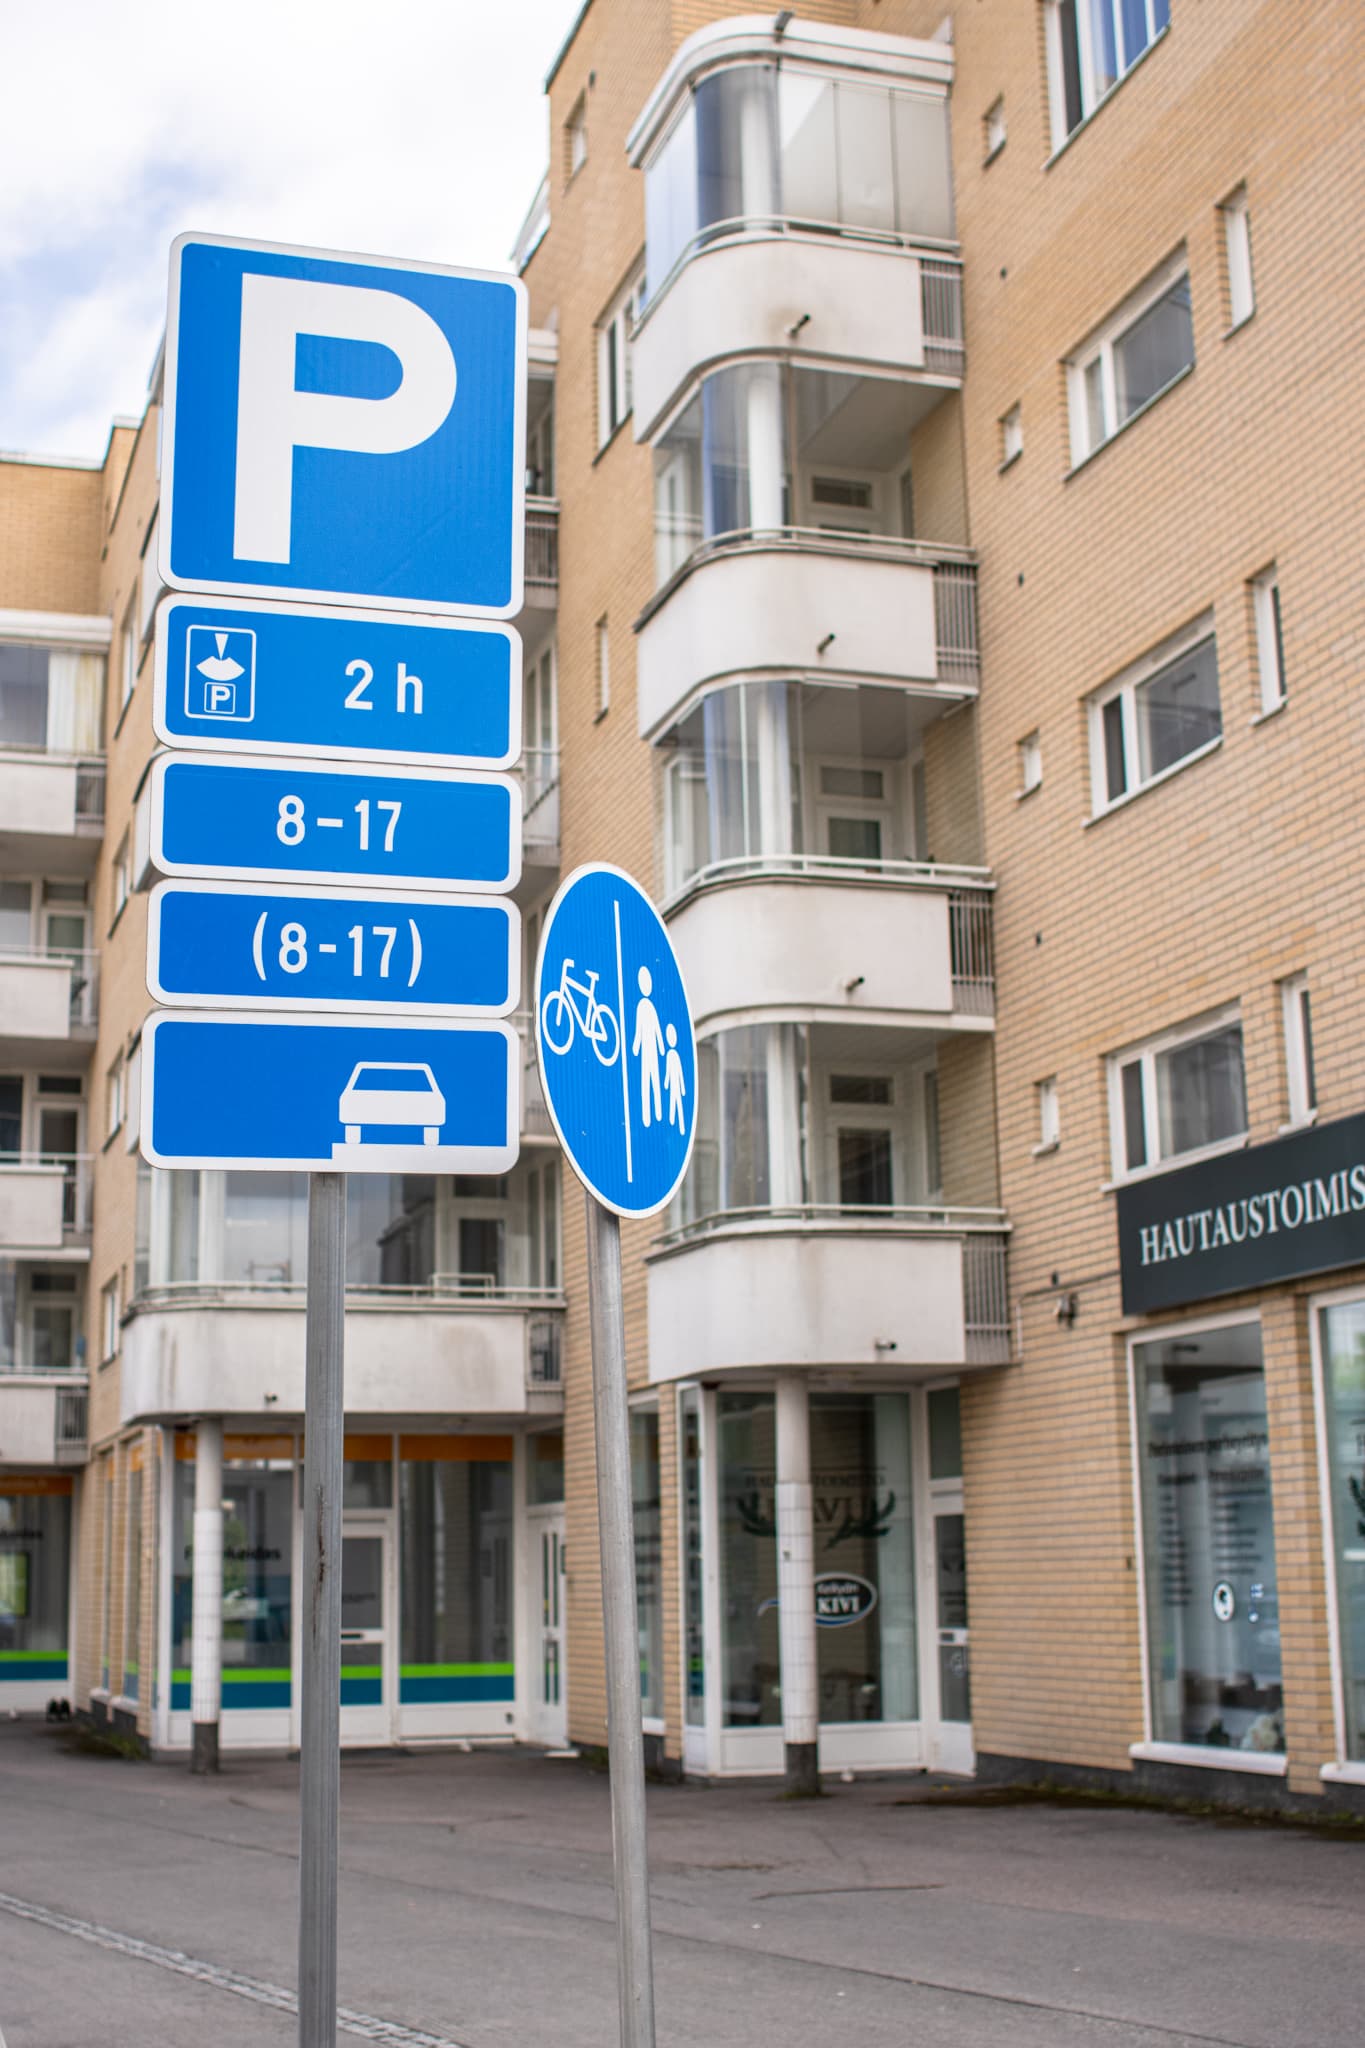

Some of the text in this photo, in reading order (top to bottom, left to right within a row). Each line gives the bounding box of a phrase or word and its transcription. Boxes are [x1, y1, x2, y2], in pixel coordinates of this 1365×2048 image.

[234, 273, 458, 565] P
[210, 685, 230, 711] P
[344, 659, 424, 715] 2 h
[1140, 1164, 1365, 1267] HAUTAUSTOIMIS
